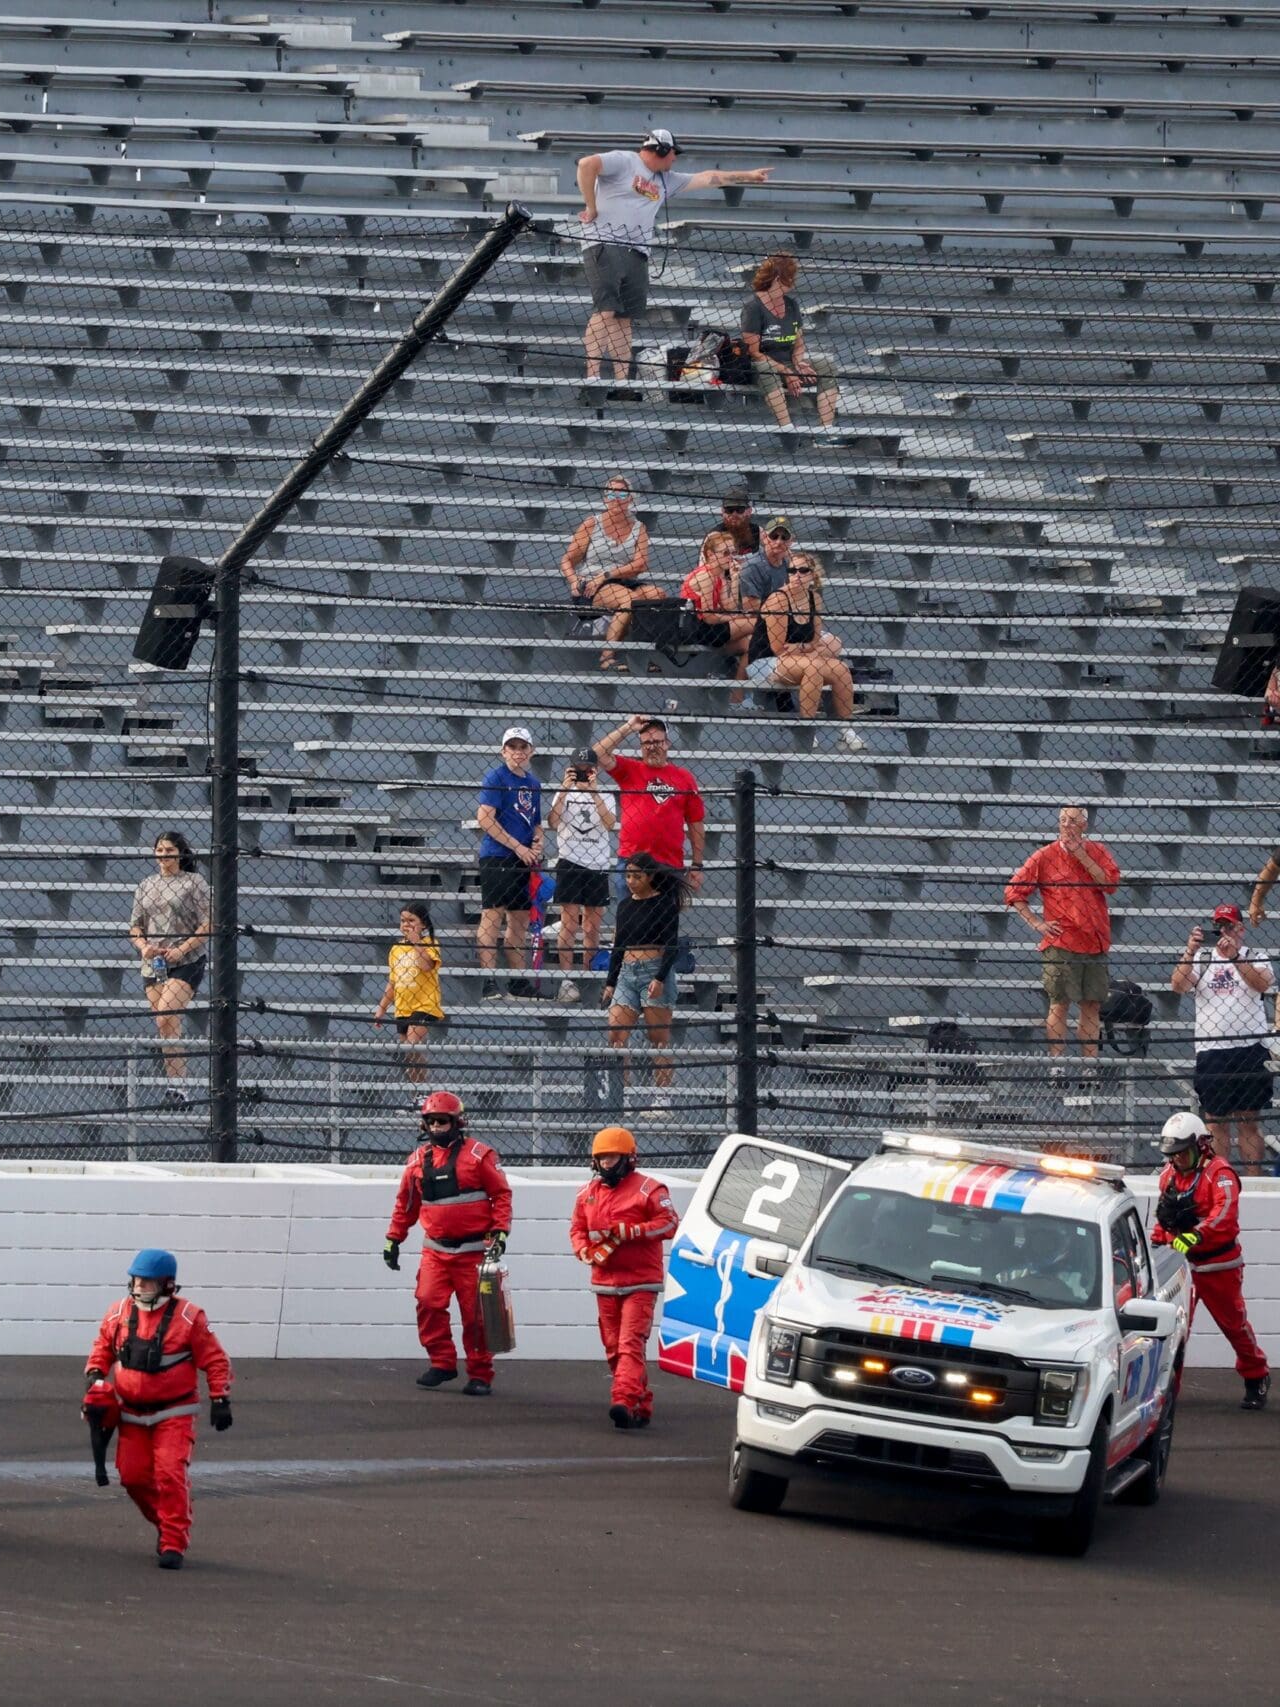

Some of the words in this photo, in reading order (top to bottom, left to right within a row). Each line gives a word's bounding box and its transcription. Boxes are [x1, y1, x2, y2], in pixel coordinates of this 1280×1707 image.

[742, 1159, 800, 1233] 2
[871, 1307, 931, 1321] SAFETY
[936, 1315, 982, 1328] TEAM
